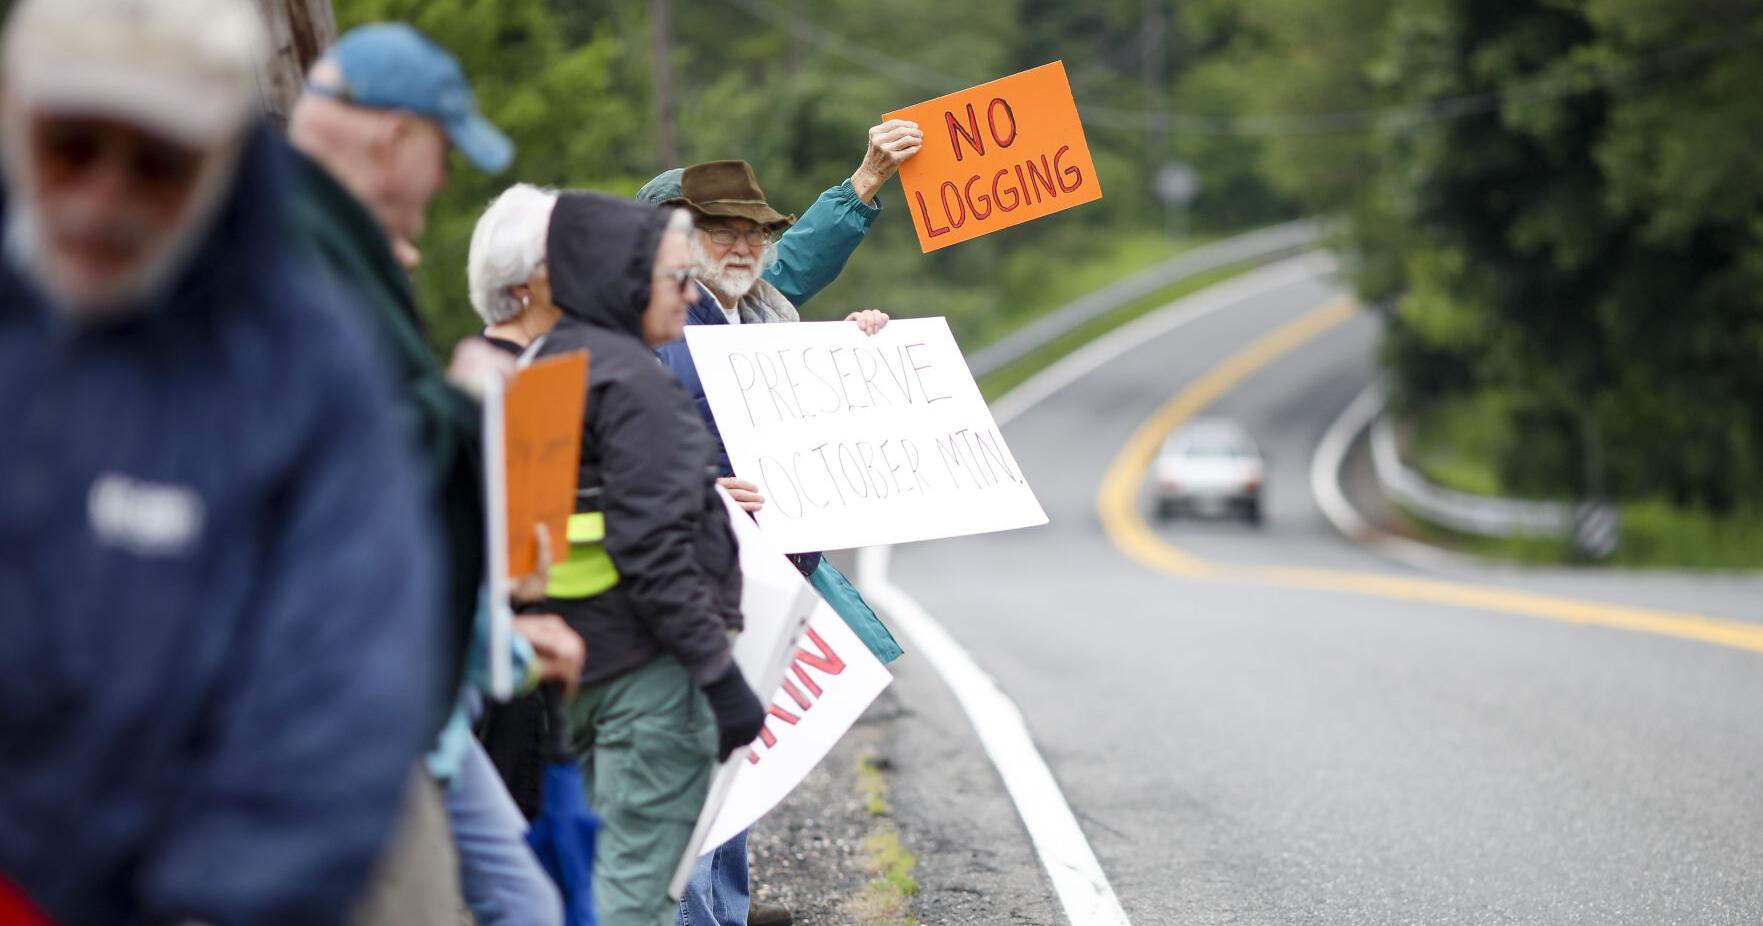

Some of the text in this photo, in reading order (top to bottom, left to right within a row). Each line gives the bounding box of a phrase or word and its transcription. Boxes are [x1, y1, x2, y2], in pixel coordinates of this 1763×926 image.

[945, 97, 1017, 161] NO
[915, 145, 1083, 238] LOGGING
[728, 343, 953, 428] PRESERVE
[758, 428, 1024, 520] OCTOBER MTN.
